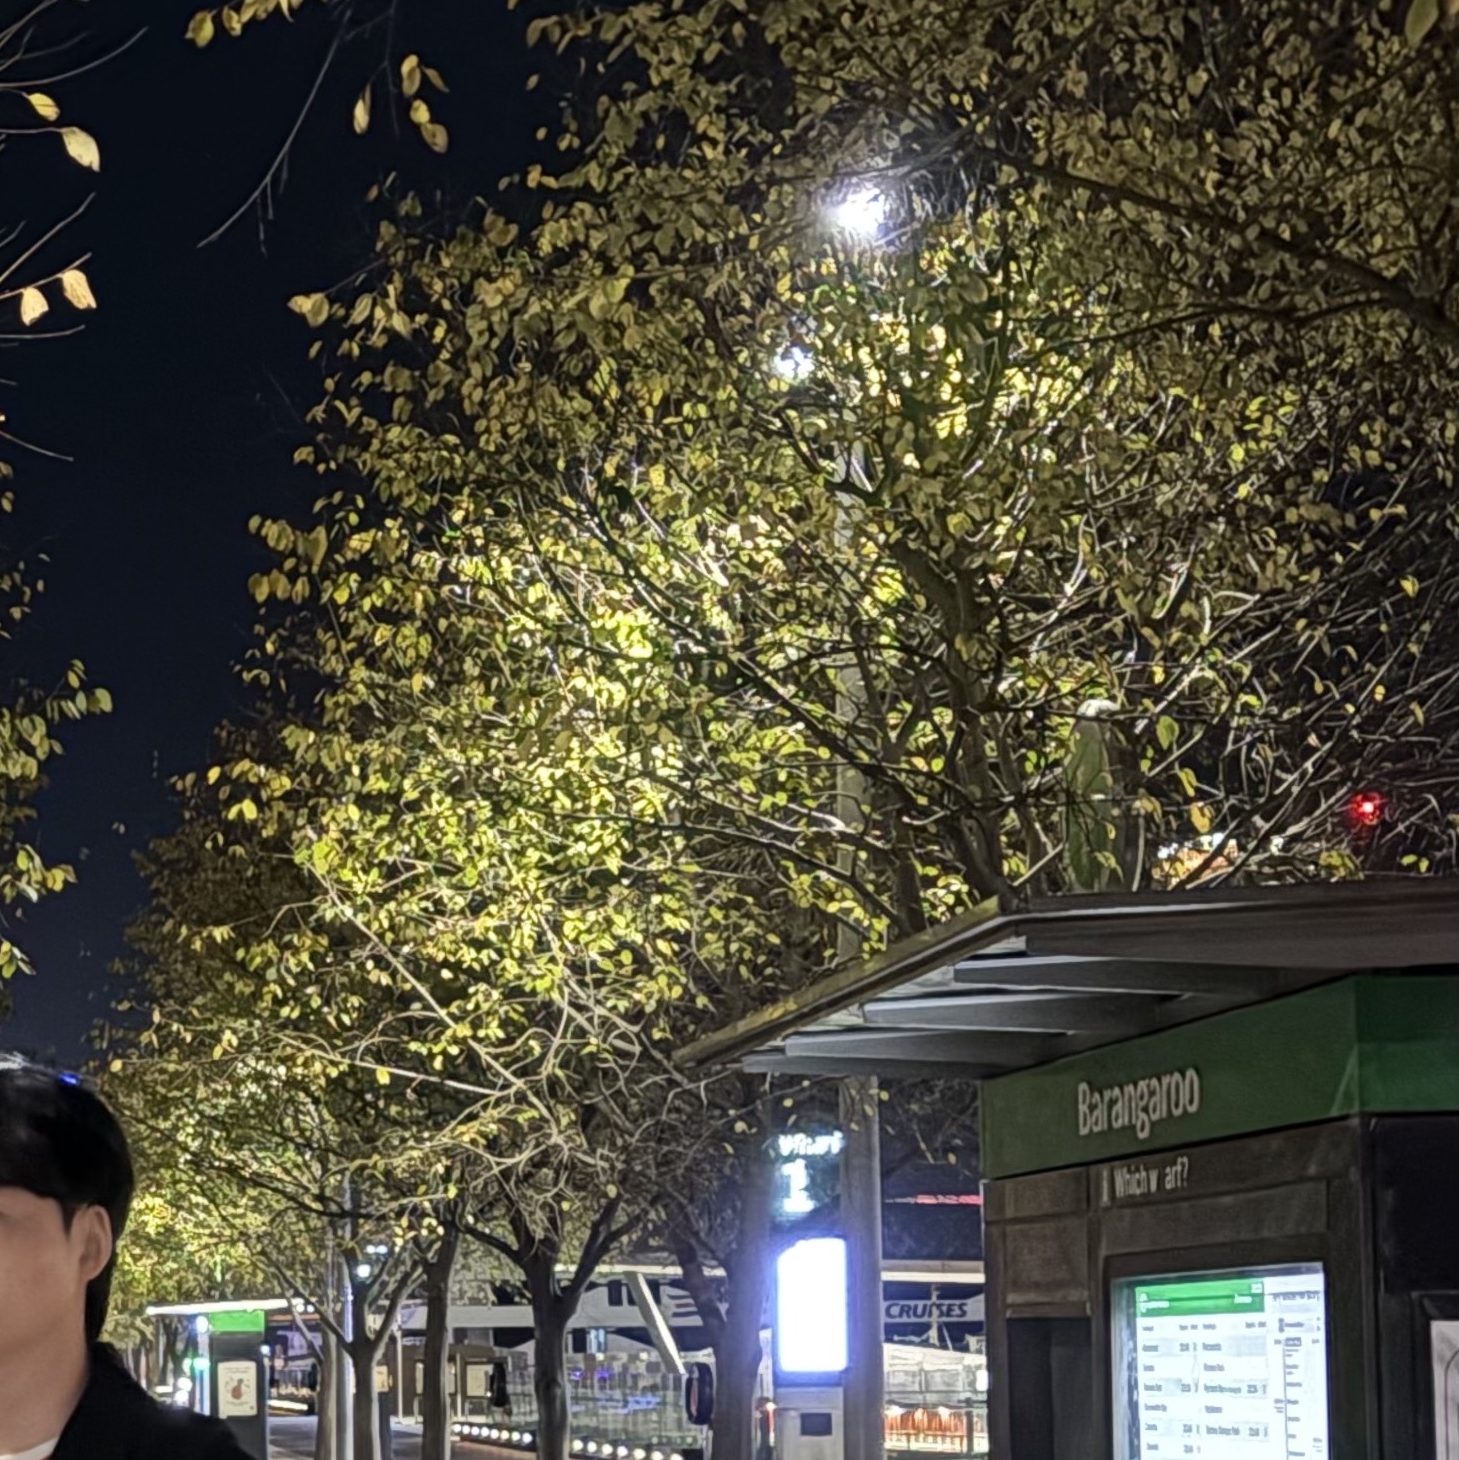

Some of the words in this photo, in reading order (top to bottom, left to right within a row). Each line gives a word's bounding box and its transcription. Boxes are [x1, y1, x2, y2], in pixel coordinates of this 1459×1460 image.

[1078, 1067, 1200, 1140] Barangaroo
[1113, 1163, 1148, 1199] Which
[884, 1302, 969, 1319] CRUISES
